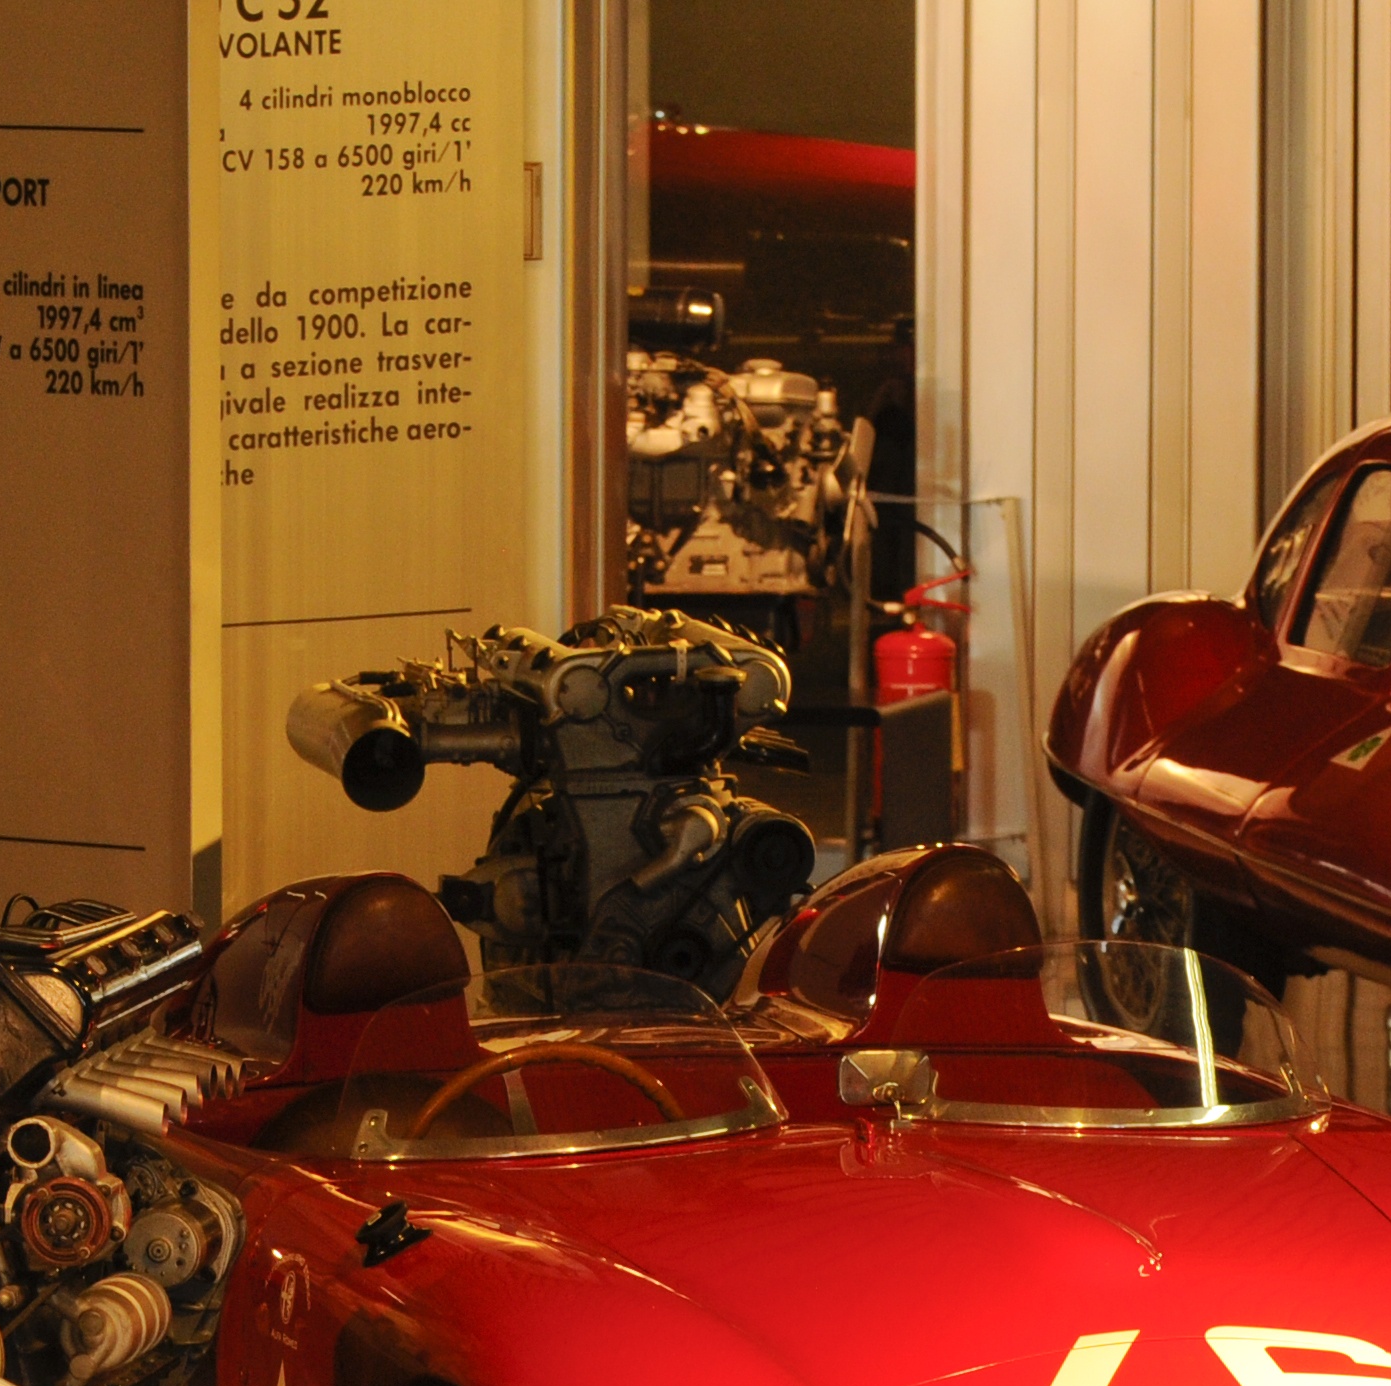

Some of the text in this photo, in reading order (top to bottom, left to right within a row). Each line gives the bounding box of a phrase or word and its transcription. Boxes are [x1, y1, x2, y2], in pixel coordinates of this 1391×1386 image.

[219, 29, 342, 59] VOLANTE
[238, 80, 472, 112] 4 cilindri monoblocco
[366, 111, 472, 138] 1997,4 cc
[221, 148, 255, 173] CV
[264, 146, 305, 171] 158
[313, 153, 328, 169] a
[336, 142, 394, 169] 6500
[360, 168, 472, 197] 220 km/h
[2, 269, 66, 298] cilindri
[72, 274, 90, 299] in
[96, 272, 144, 301] linea
[255, 279, 287, 309] da
[308, 275, 473, 312] competizione
[36, 304, 103, 335] 1997,4
[219, 311, 473, 346] dello 1900. La car-
[8, 343, 23, 361] a
[28, 336, 81, 363] 6500
[240, 362, 256, 381] a
[270, 350, 363, 379] sezione
[376, 350, 473, 373] trasver-
[44, 368, 84, 396] 220
[90, 369, 145, 398] km/h
[303, 381, 400, 412] realizza
[417, 380, 473, 405] inte-
[227, 415, 473, 452] caratteristiche aero-
[219, 458, 255, 487] he
